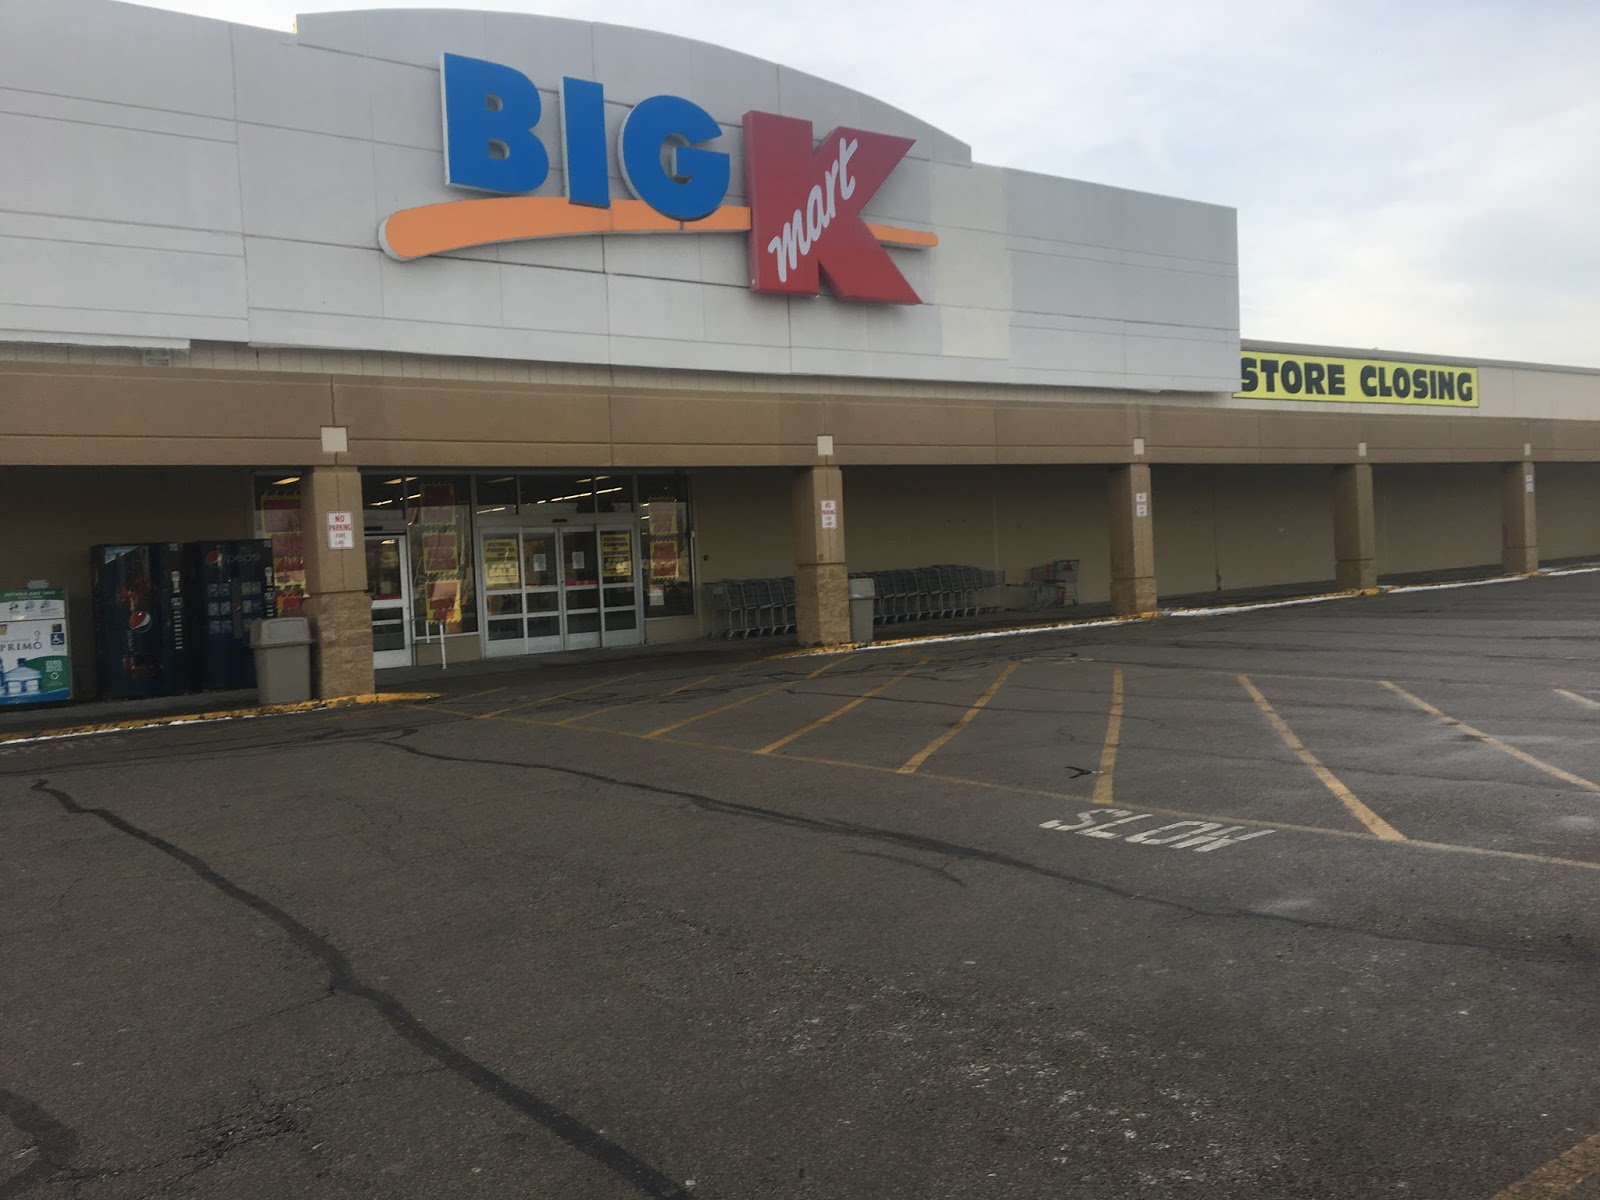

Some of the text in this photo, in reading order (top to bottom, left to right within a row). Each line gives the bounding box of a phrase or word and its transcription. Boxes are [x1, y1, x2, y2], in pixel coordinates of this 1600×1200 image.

[440, 52, 921, 306] BIG K
[767, 137, 859, 283] mart
[1241, 357, 1473, 402] STORE CLOSING
[329, 524, 352, 532] PARKING
[335, 514, 345, 523] NO
[0, 641, 42, 652] PRIMO
[1039, 808, 1277, 853] SLOW
